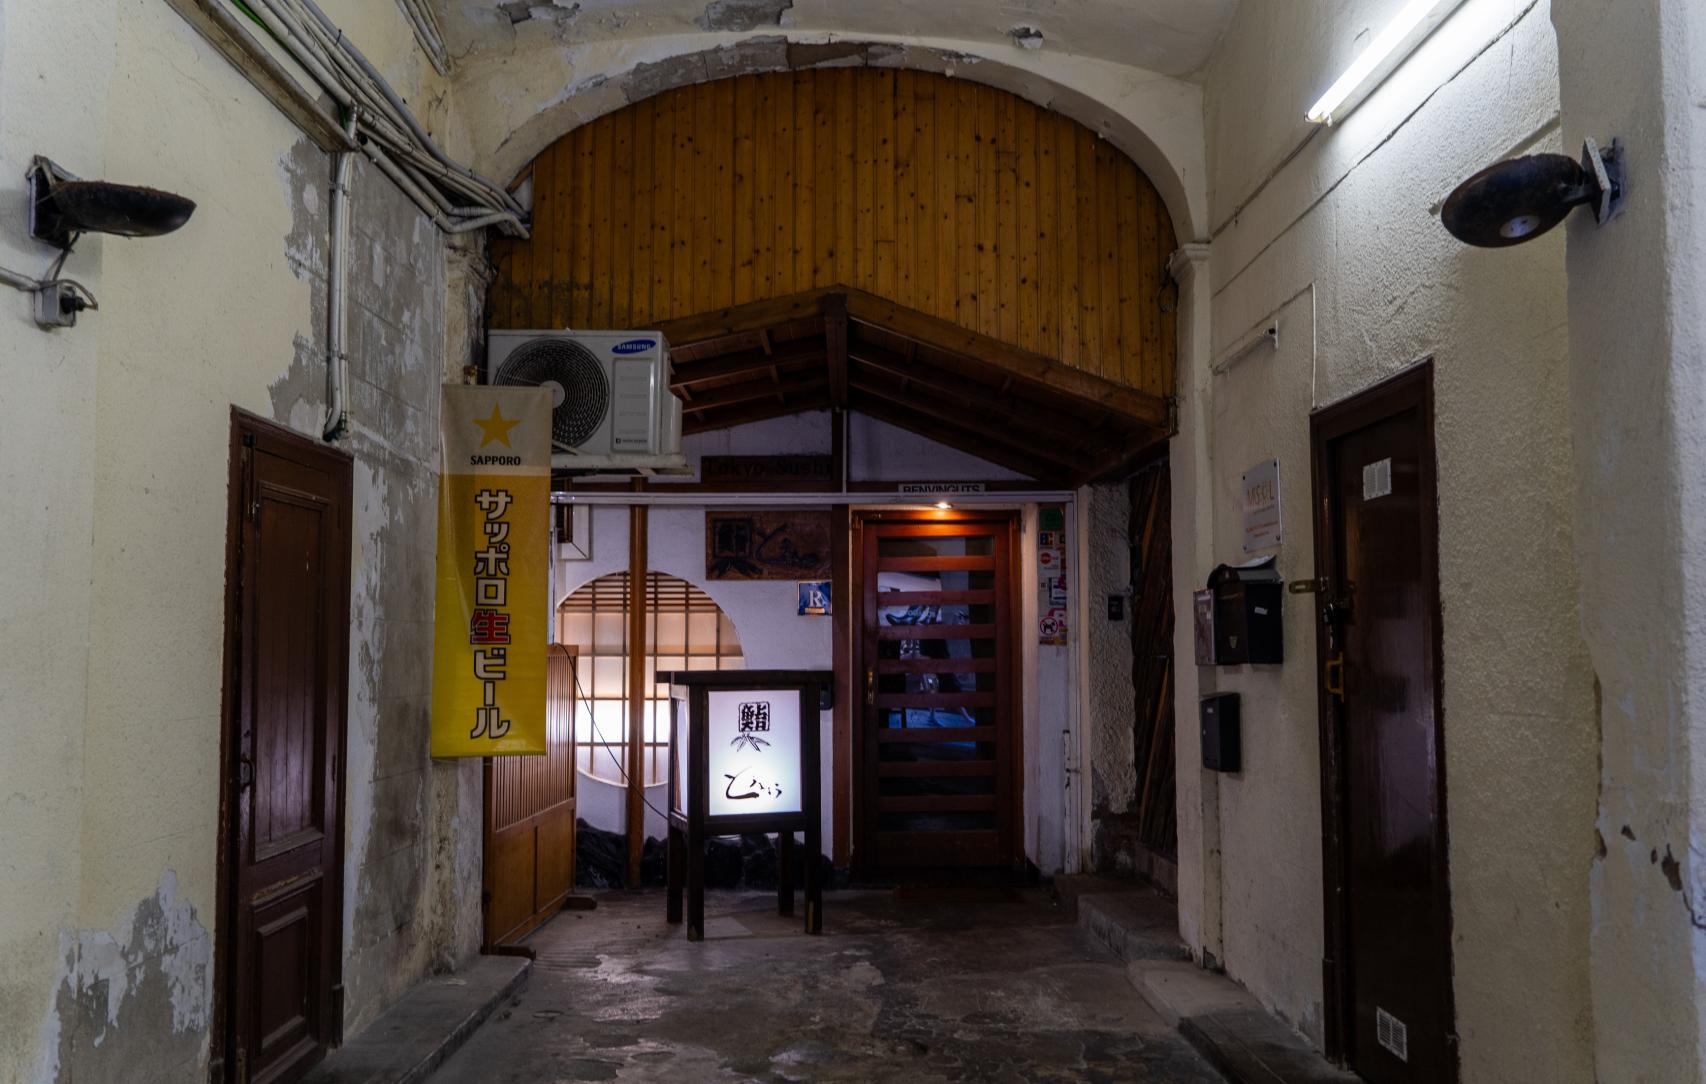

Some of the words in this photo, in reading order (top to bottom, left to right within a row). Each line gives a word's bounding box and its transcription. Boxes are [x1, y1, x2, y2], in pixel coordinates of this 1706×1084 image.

[617, 343, 652, 351] SAMSUNG
[470, 456, 521, 466] SAPPORO
[704, 457, 764, 479] Tokyo
[776, 457, 832, 474] Sushi
[470, 489, 512, 740] サッポロ生ビール
